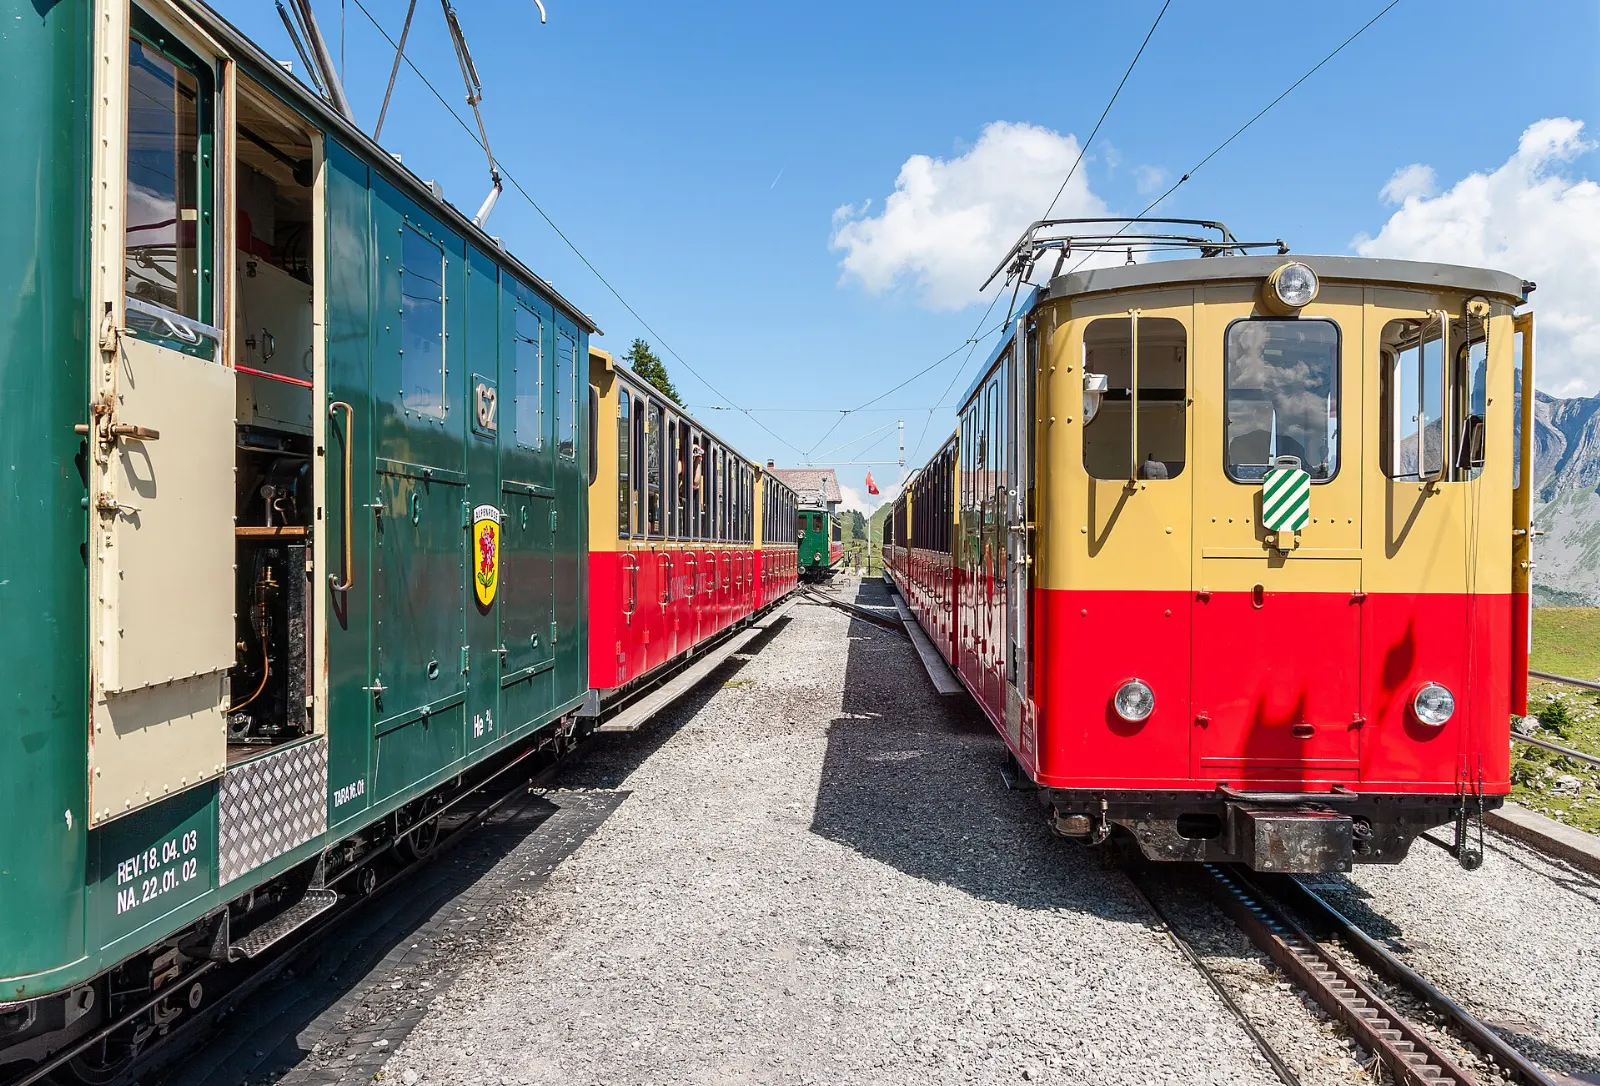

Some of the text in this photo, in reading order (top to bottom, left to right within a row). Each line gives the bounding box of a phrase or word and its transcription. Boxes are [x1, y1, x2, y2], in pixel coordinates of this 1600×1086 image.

[475, 383, 497, 431] 62
[475, 508, 499, 522] ALPENROSE
[473, 713, 484, 739] He
[182, 829, 197, 855] 03
[117, 886, 140, 915] NA.
[182, 857, 197, 882] 02
